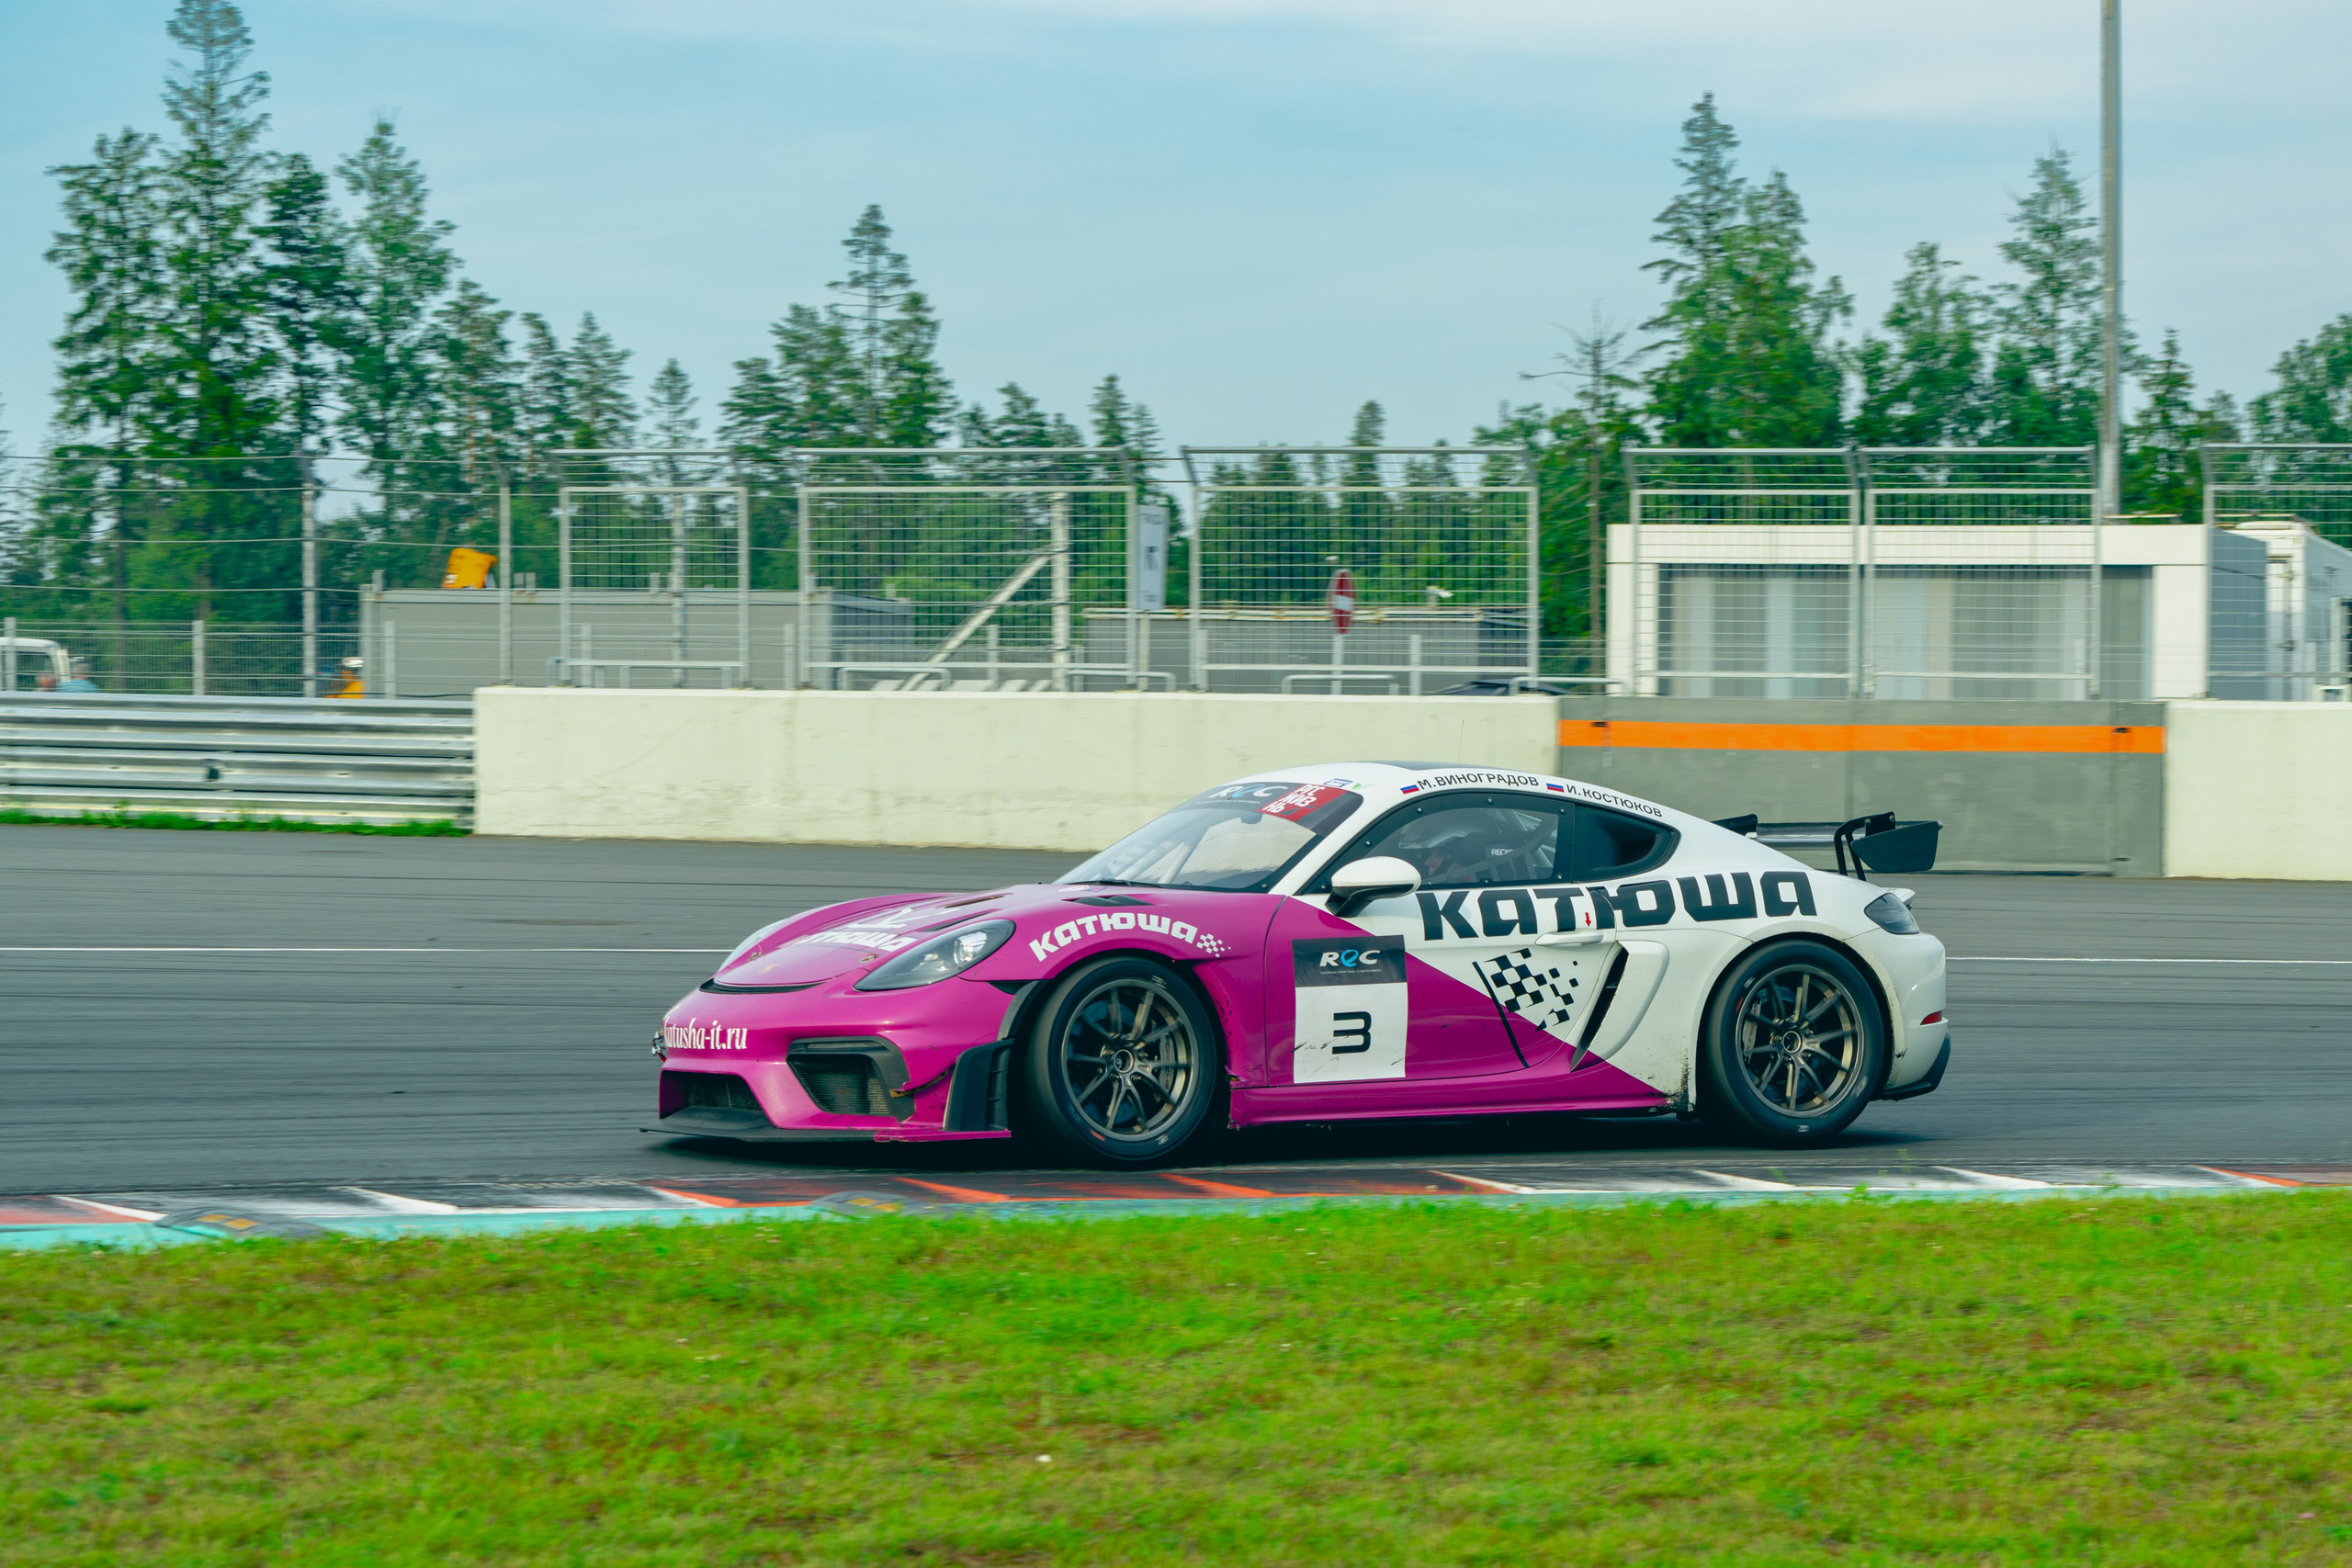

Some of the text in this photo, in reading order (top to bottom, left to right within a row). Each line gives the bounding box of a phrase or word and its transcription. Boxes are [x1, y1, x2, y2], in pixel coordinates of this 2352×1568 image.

[1417, 772, 1540, 791] М.ВИНОГРАДОВ
[1566, 784, 1663, 818] И.КОСТЮКОВ
[1331, 1010, 1372, 1055] 3
